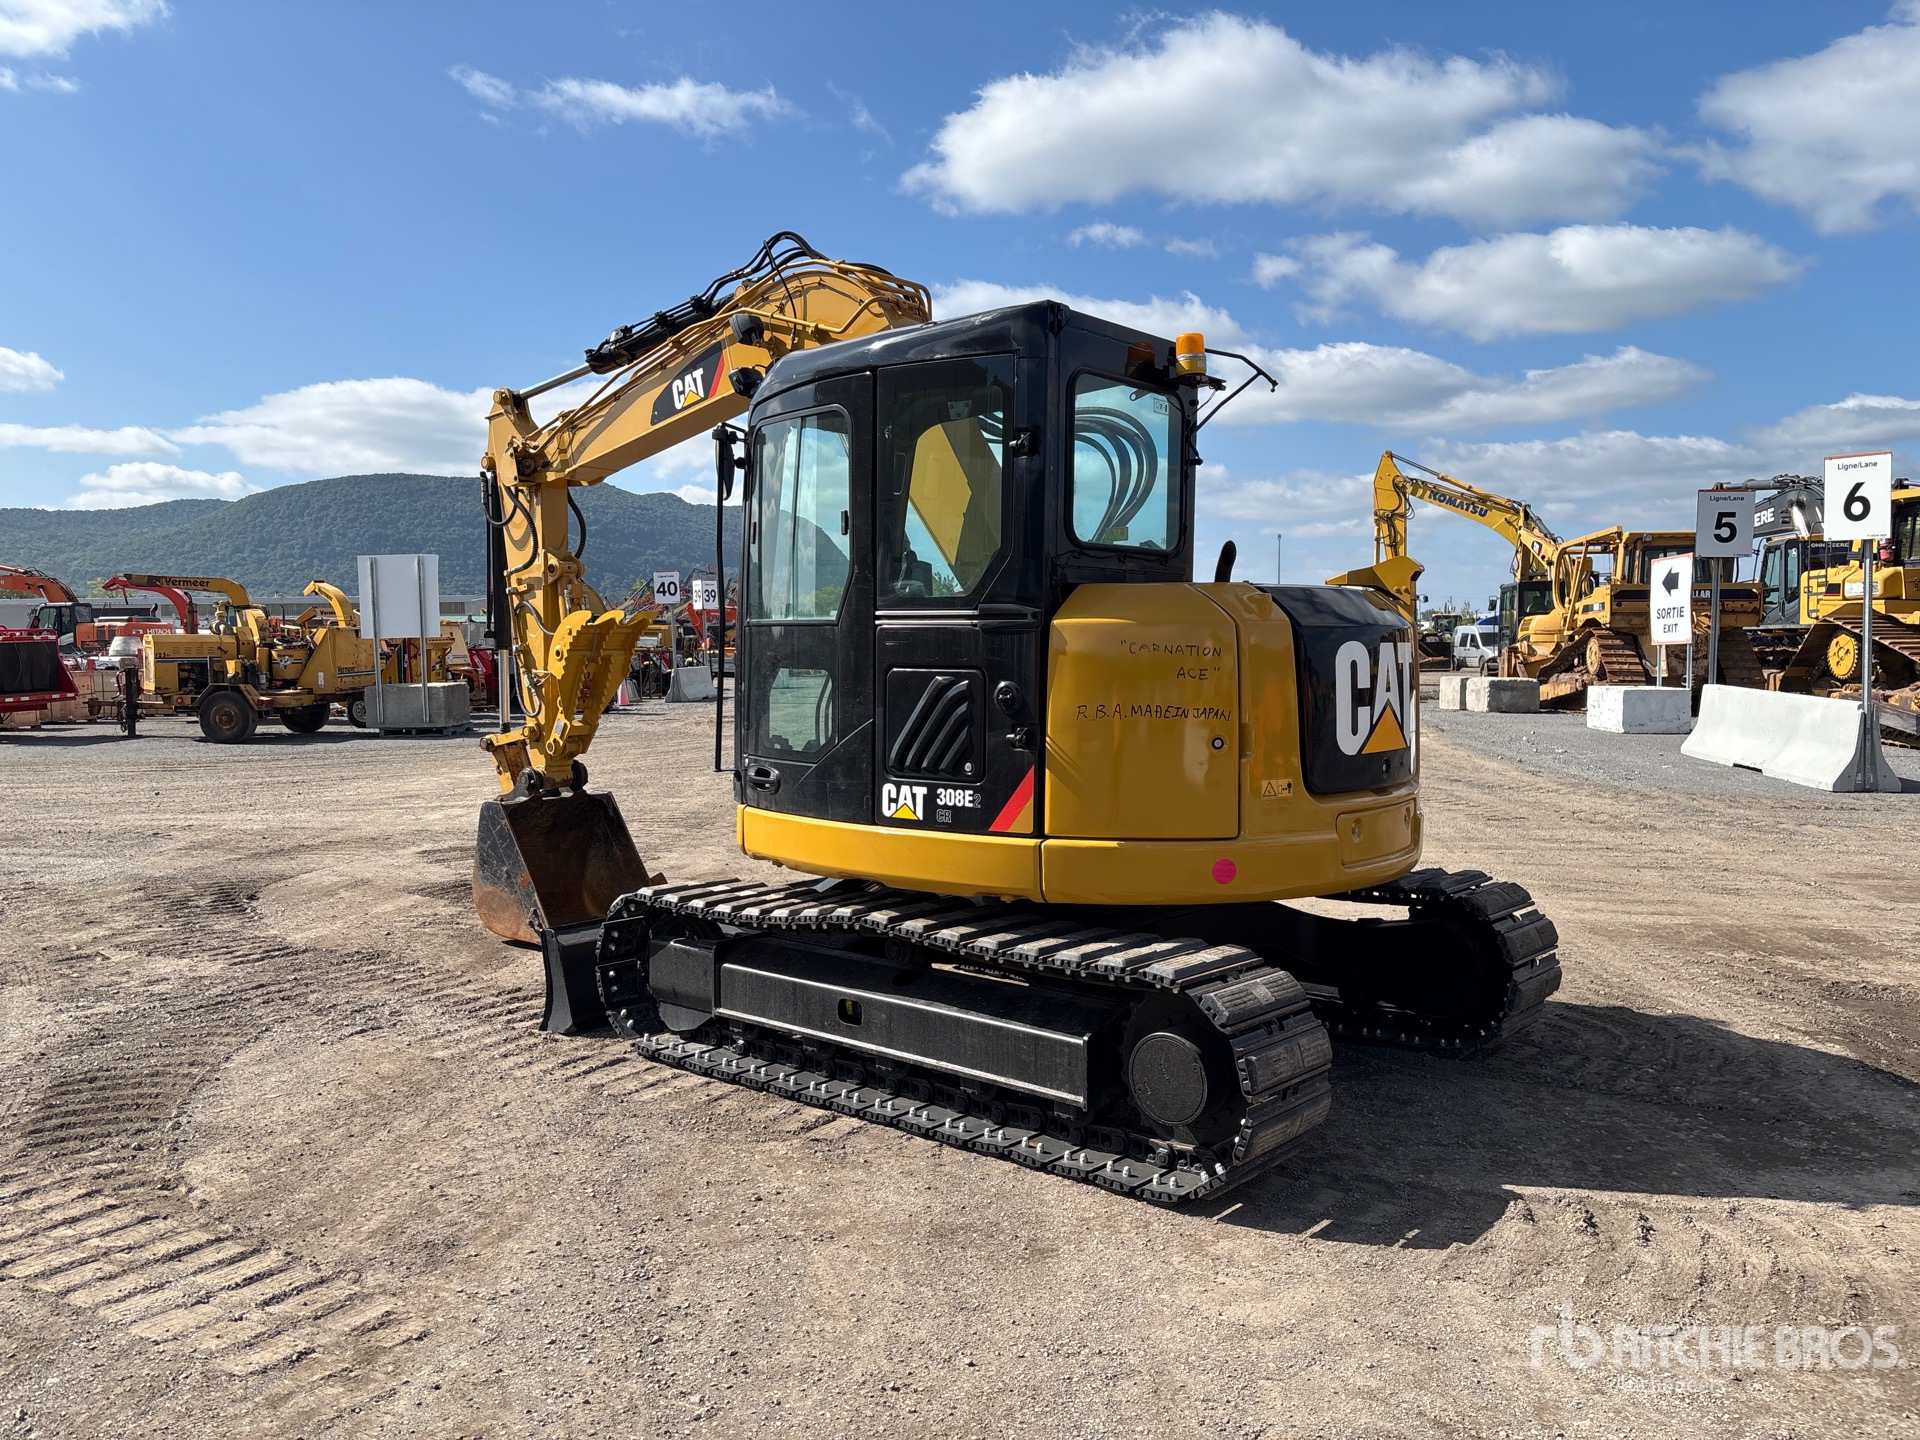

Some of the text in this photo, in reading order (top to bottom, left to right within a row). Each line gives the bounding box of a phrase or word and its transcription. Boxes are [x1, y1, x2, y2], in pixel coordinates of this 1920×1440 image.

[672, 367, 705, 410] CAT
[1837, 461, 1878, 471] Ligne/Lane
[1428, 490, 1489, 518] KOMATSU
[1843, 481, 1872, 522] 6
[1754, 507, 1775, 528] ERE
[1713, 511, 1738, 544] 5
[165, 578, 210, 588] Vermeer
[656, 581, 678, 597] 40
[703, 589, 717, 603] 39
[1656, 606, 1685, 619] SORTIE
[1663, 623, 1679, 634] EXIT
[1335, 640, 1413, 756] CAT
[882, 783, 928, 821] CAT
[936, 808, 952, 823] CR
